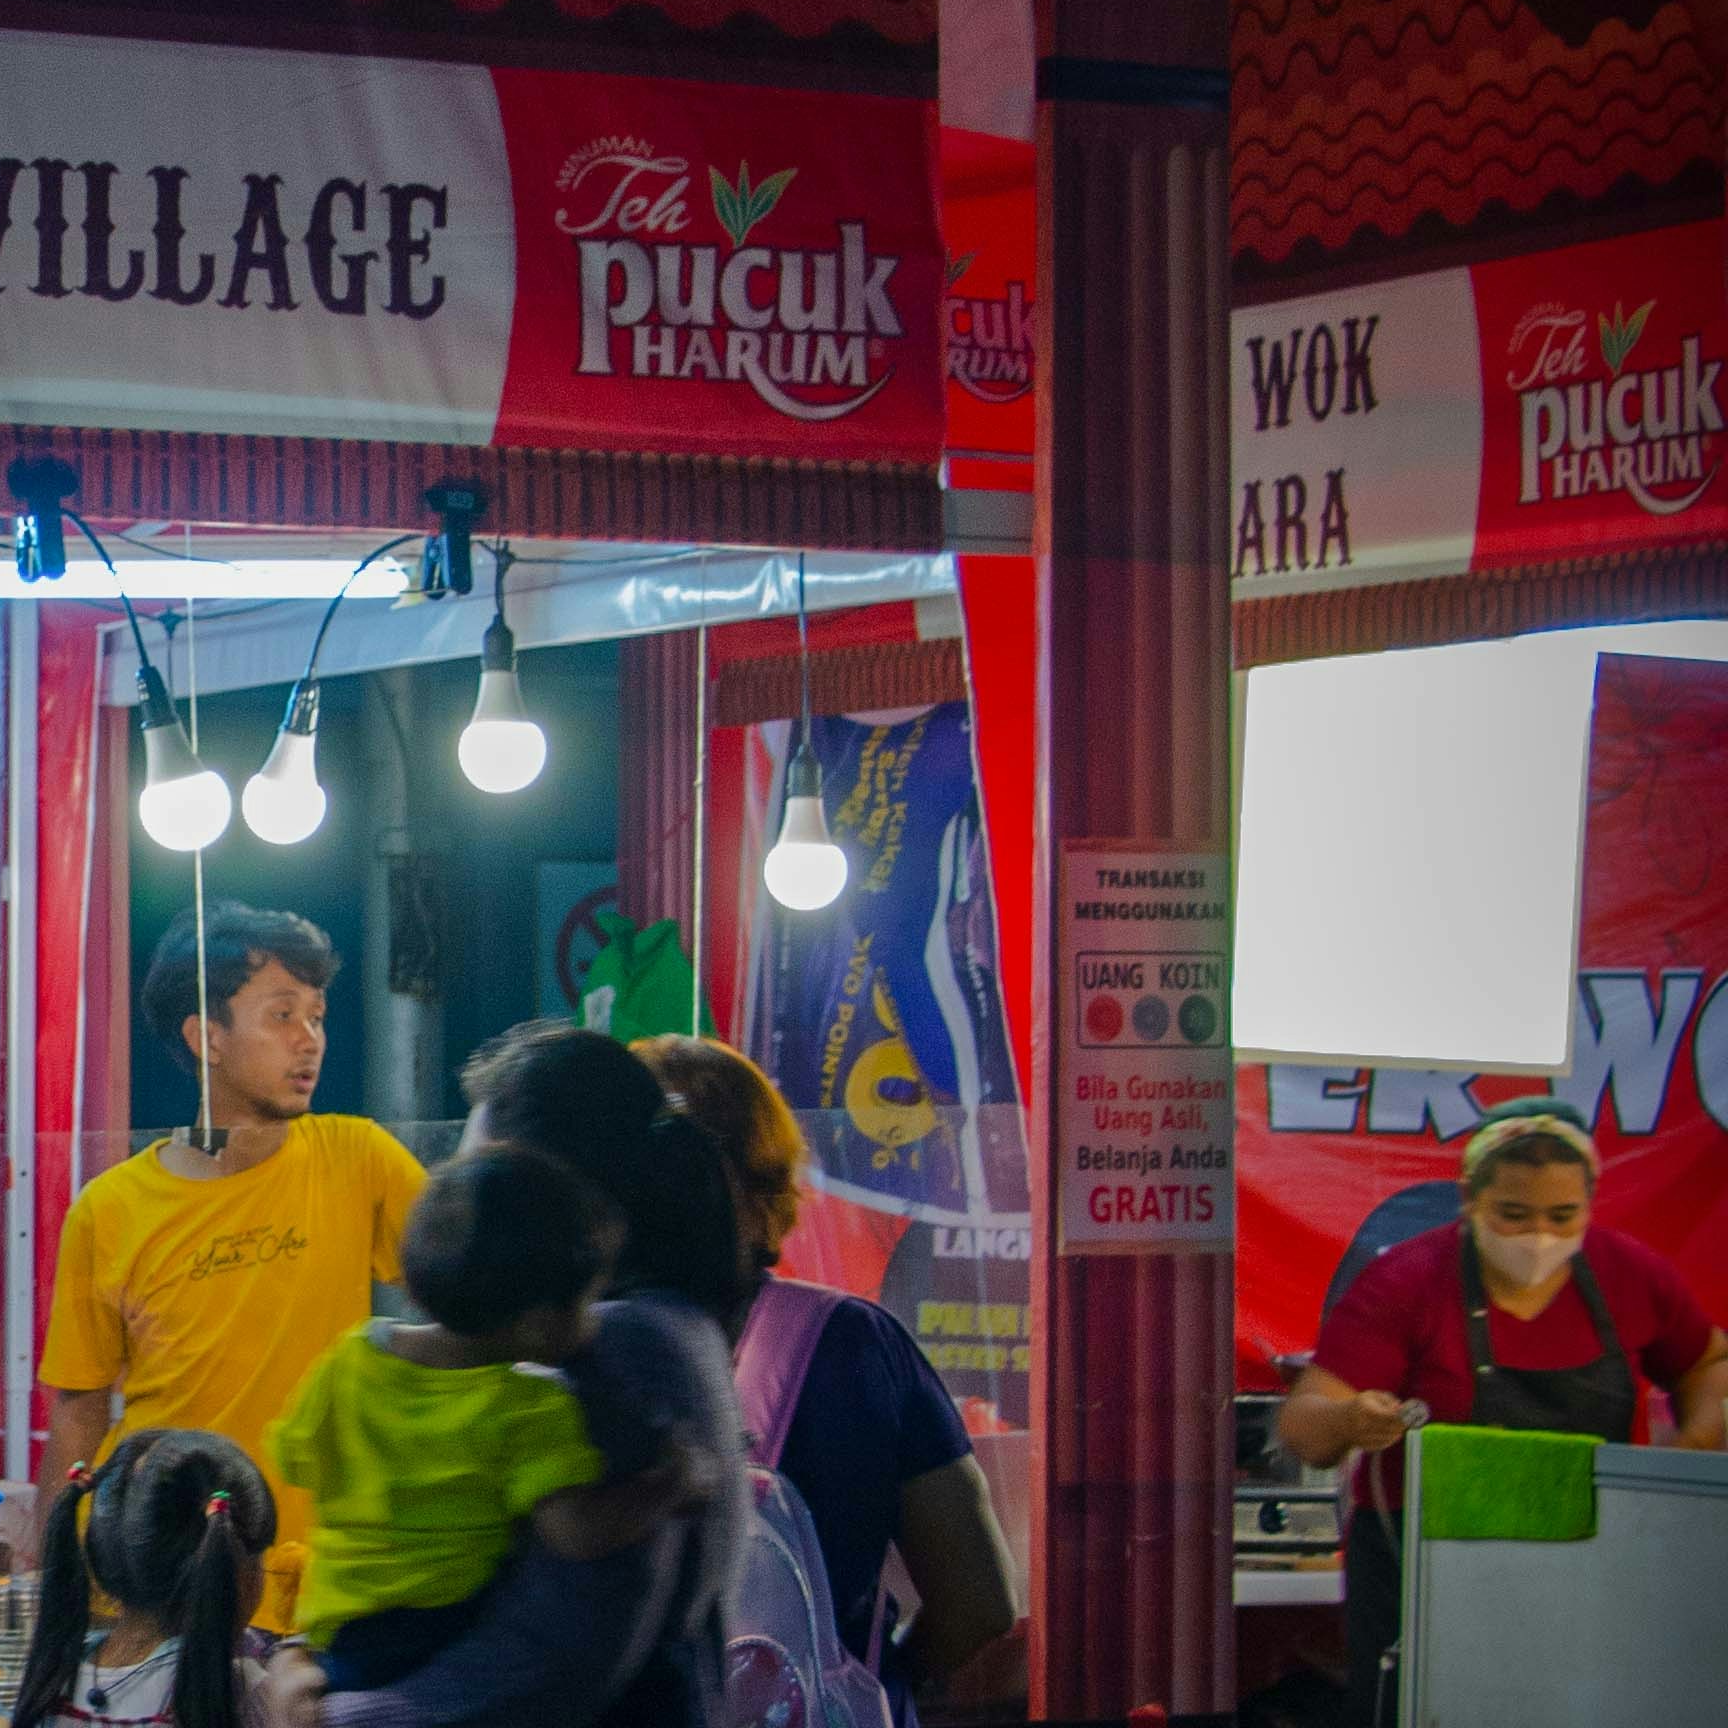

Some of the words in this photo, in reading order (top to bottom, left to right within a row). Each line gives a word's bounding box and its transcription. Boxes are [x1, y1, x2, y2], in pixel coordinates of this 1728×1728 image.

[555, 154, 692, 233] Teh
[577, 220, 904, 374] pucuk
[632, 327, 880, 404] HARUM
[1246, 315, 1379, 431] WOK
[1505, 308, 1590, 391] Teh
[1552, 432, 1712, 508] HARUM
[1233, 468, 1353, 577] ARA
[1095, 870, 1206, 889] TRANSAKSI
[1075, 902, 1226, 921] MENGGUNAKAN
[1082, 962, 1144, 991] UANG
[1160, 962, 1220, 990] KOIN
[1076, 1076, 1118, 1102] Bila
[1127, 1076, 1227, 1100] Gunakan
[1095, 1107, 1152, 1136] Uang
[1160, 1106, 1208, 1133] Asli,
[1077, 1146, 1162, 1176] Belanja
[1171, 1145, 1228, 1171] Anda
[1089, 1185, 1215, 1224] GRATIS
